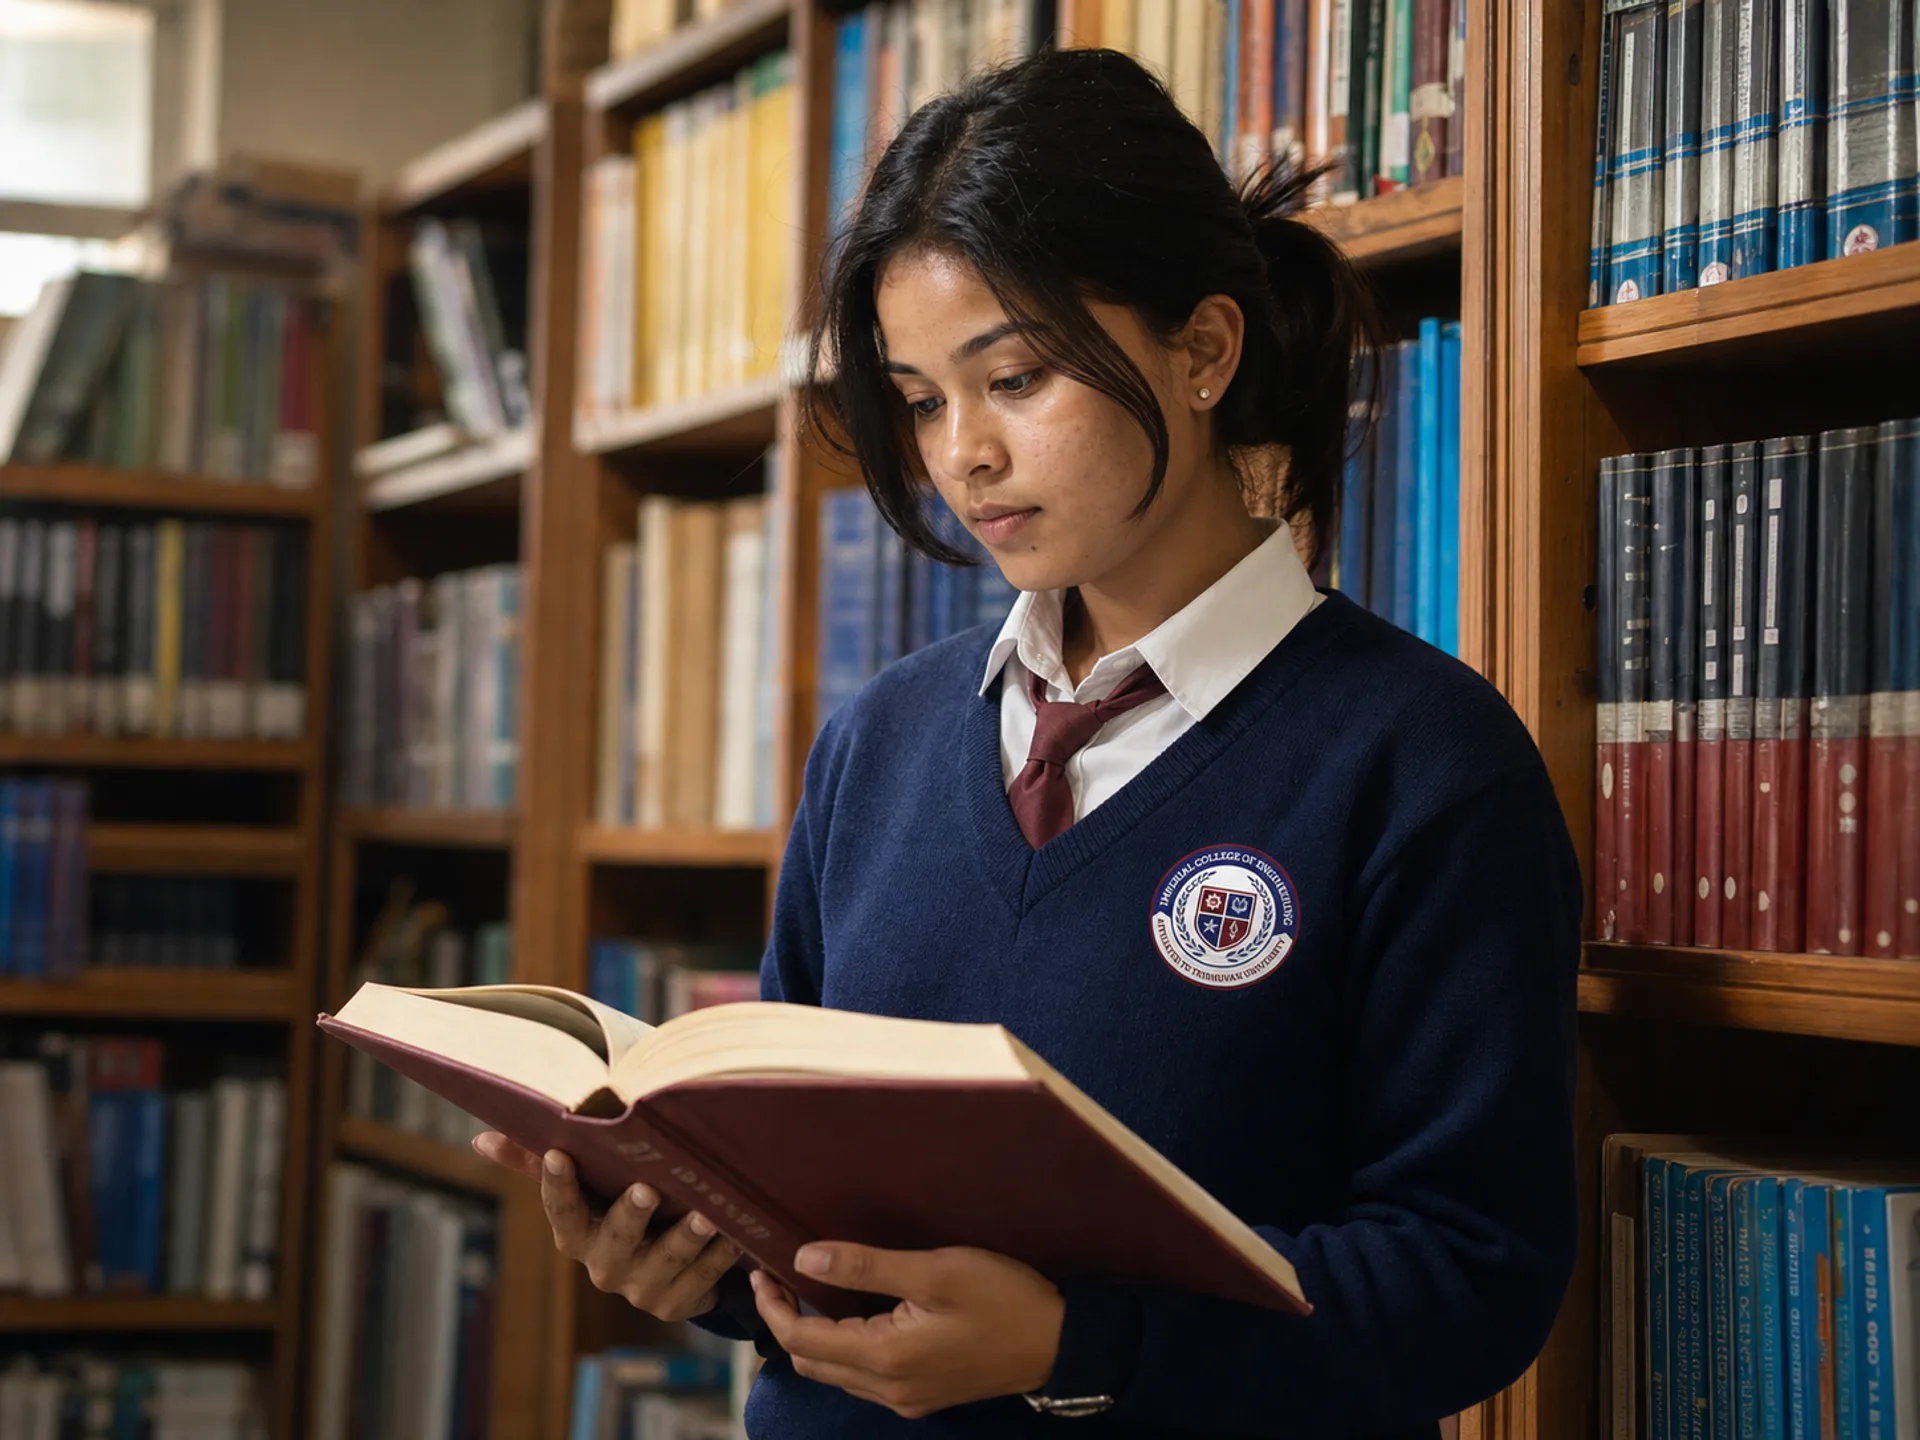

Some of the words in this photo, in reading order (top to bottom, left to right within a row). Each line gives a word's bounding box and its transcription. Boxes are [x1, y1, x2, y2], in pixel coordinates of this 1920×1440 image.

[1194, 851, 1241, 867] COLLEGE
[1241, 854, 1257, 865] OF
[1180, 960, 1192, 972] TO
